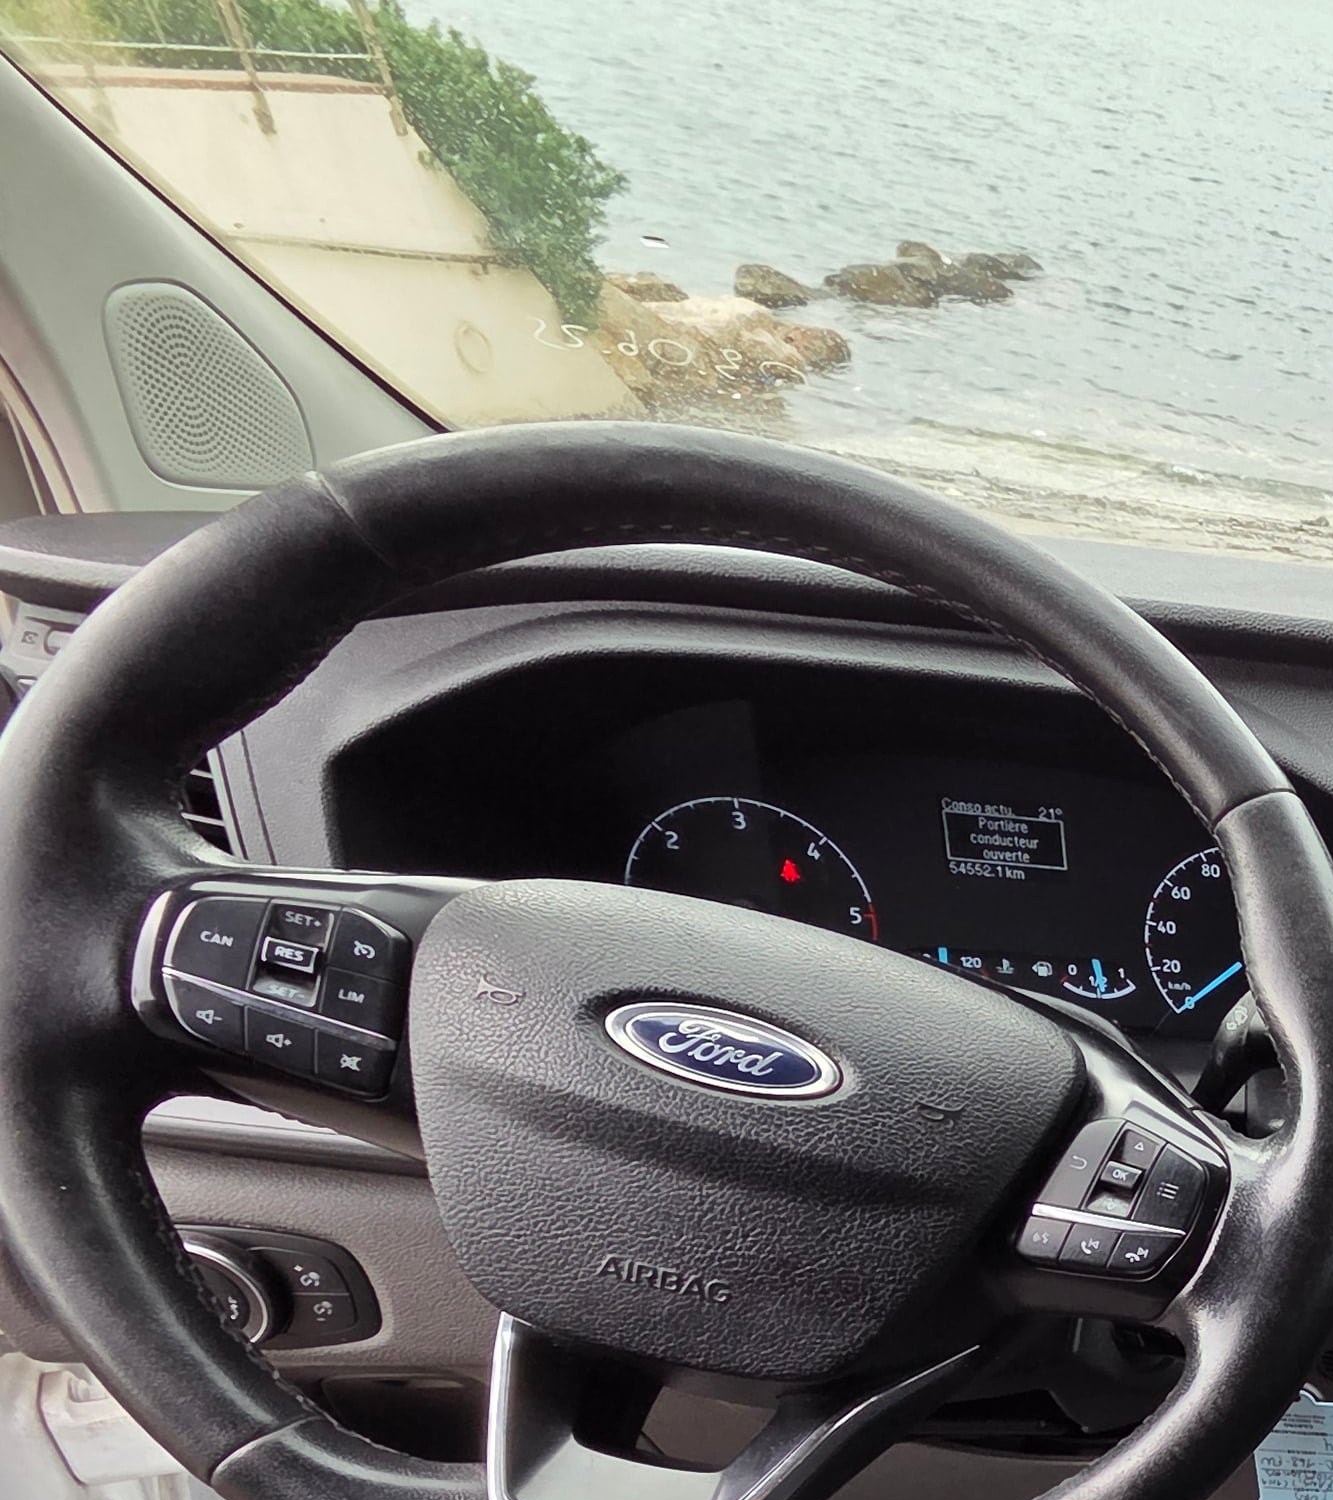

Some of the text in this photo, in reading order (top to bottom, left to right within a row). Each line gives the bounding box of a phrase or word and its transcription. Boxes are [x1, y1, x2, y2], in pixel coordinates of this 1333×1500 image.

[732, 812, 746, 829] 3
[978, 817, 1028, 833] Portière
[665, 831, 679, 849] 2
[970, 833, 1039, 849] conducteur
[807, 842, 821, 860] 4
[983, 849, 1030, 863] ouverte
[1005, 867, 1025, 880] km
[1201, 864, 1220, 878] 80
[1171, 886, 1191, 900] 60
[850, 907, 862, 924] 5
[1157, 921, 1176, 934] 40
[200, 930, 234, 947] CAN
[275, 945, 304, 962] RES
[960, 956, 982, 969] 120
[1068, 964, 1077, 975] 0
[1162, 959, 1181, 973] 20
[1118, 968, 1125, 979] 1
[338, 989, 365, 1003] LIM
[658, 1018, 784, 1077] Ford
[1112, 1168, 1129, 1181] OK
[597, 1254, 733, 1303] AIRBAG
